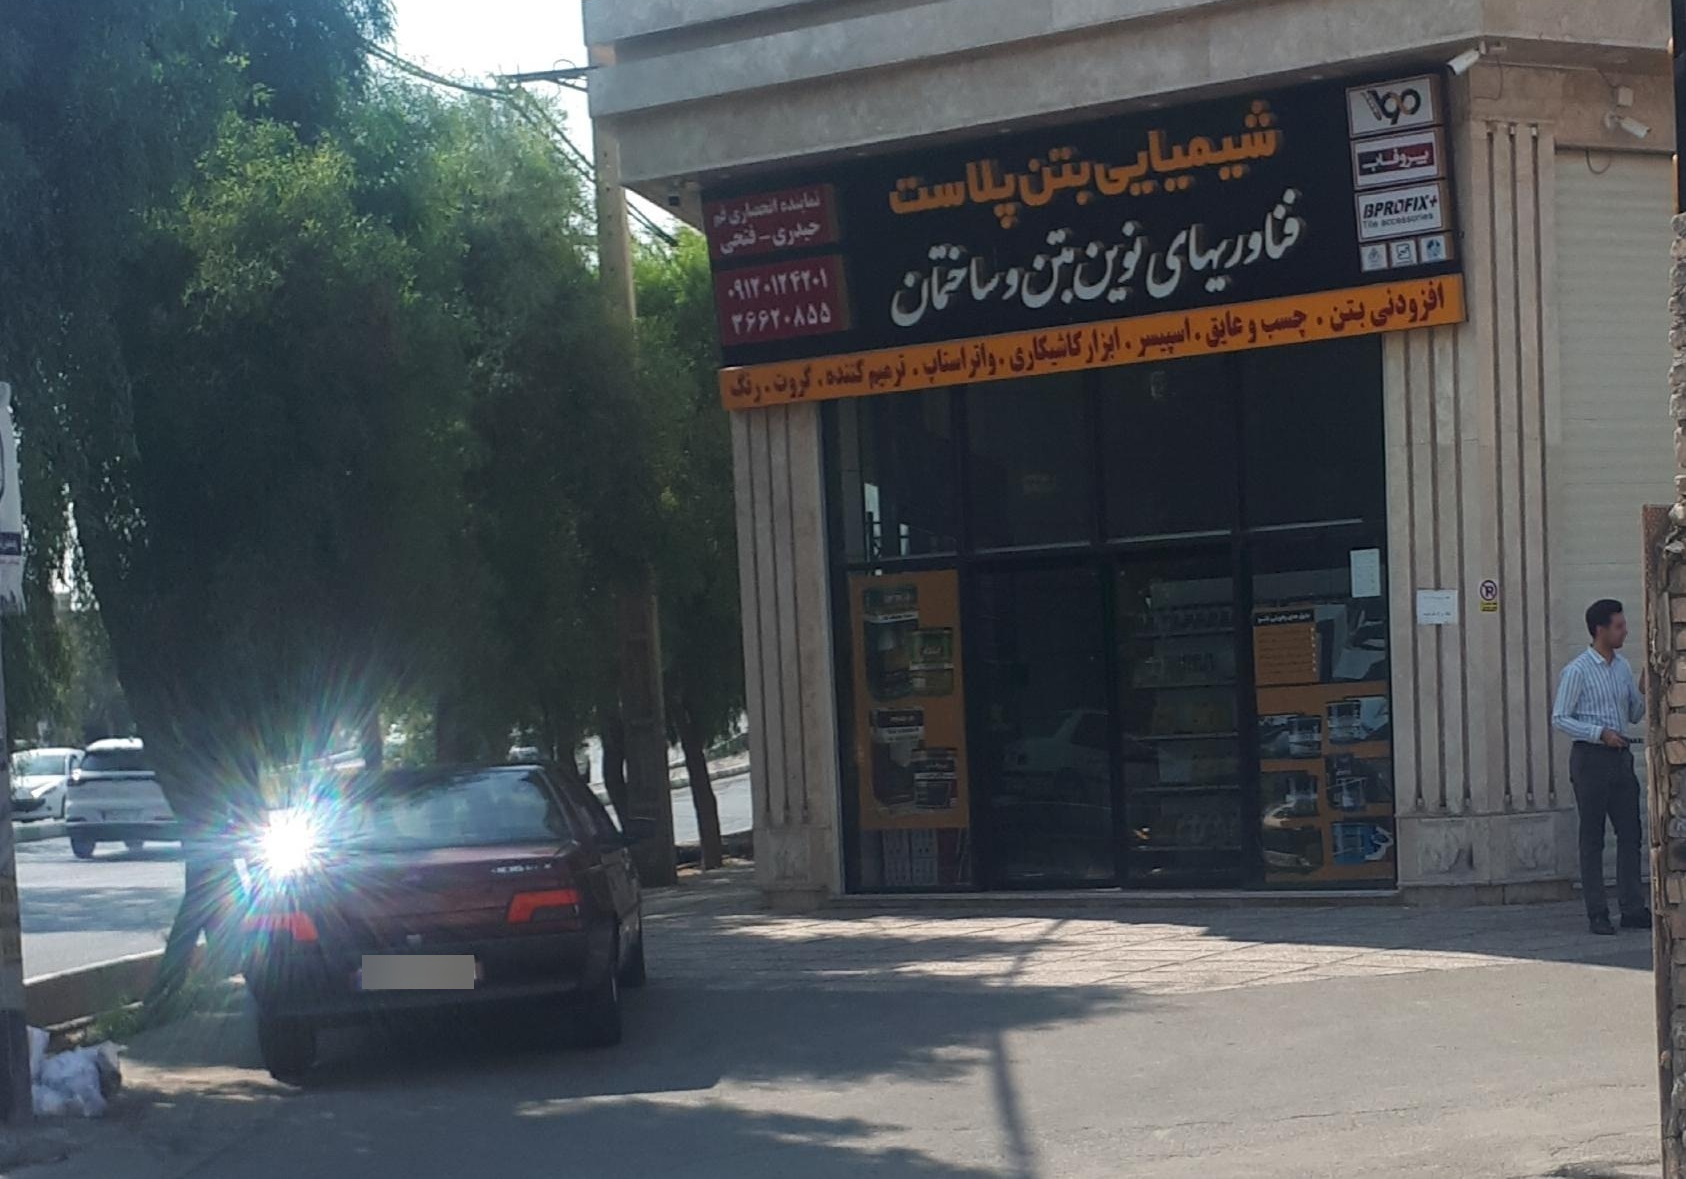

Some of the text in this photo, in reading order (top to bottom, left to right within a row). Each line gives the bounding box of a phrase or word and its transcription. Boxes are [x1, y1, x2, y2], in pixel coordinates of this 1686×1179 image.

[889, 100, 1277, 230] شیمیایی بتن پلاست
[1021, 228, 1075, 309] بتن
[1073, 221, 1143, 304] نوین
[890, 245, 1000, 327] ساختمان
[1001, 267, 1019, 301] و
[1330, 299, 1366, 333] بتن
[1370, 280, 1445, 327] افزودنی
[1206, 310, 1243, 348] عایق
[1247, 319, 1257, 344] و
[1261, 309, 1307, 340] چسب
[1086, 325, 1121, 363] ابزار
